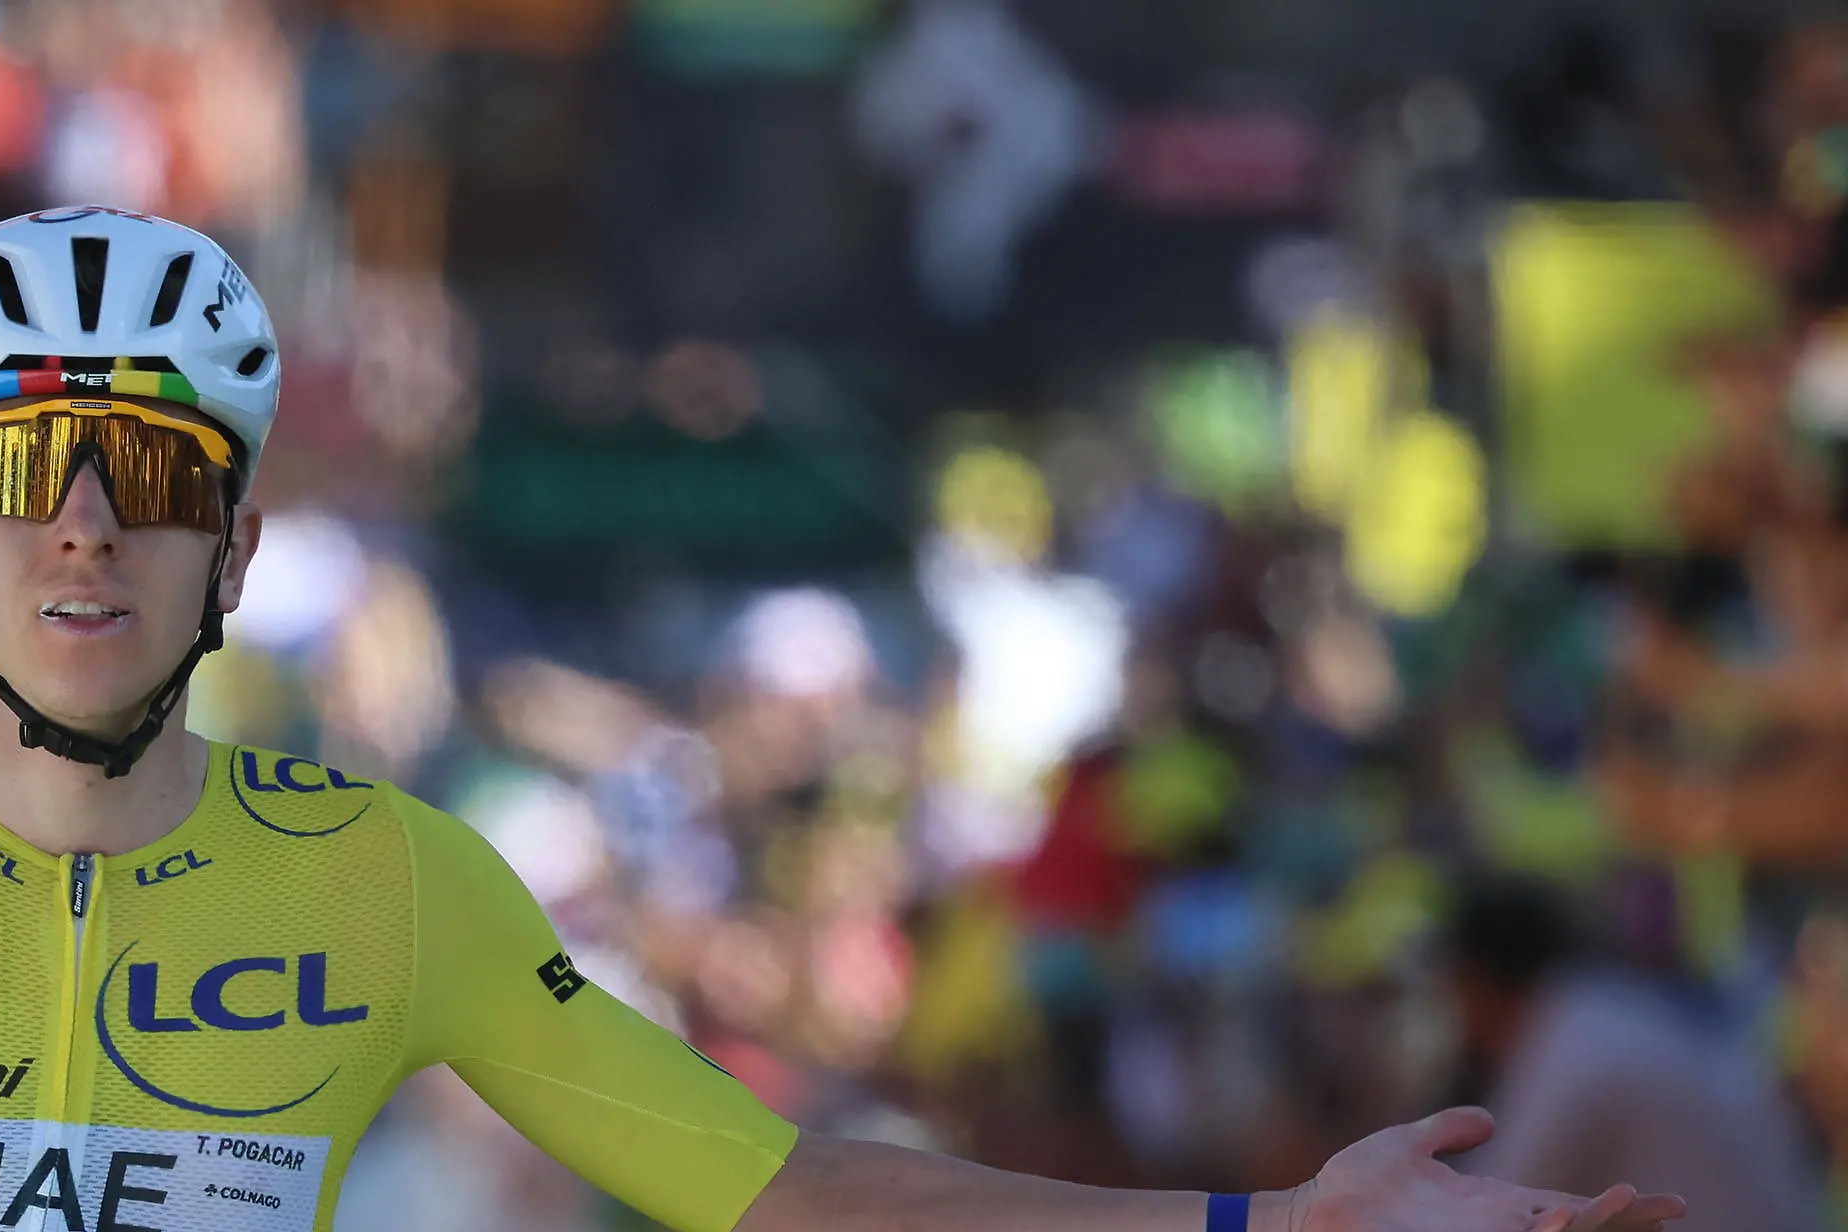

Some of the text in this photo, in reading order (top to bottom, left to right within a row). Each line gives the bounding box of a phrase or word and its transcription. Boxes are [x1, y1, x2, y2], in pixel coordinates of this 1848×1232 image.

[60, 371, 120, 387] MET
[240, 750, 374, 793] LCL
[134, 848, 213, 887] LCL
[127, 951, 370, 1034] LCL
[197, 1135, 306, 1171] T. POGACAR
[220, 1186, 282, 1210] COLNAGO
